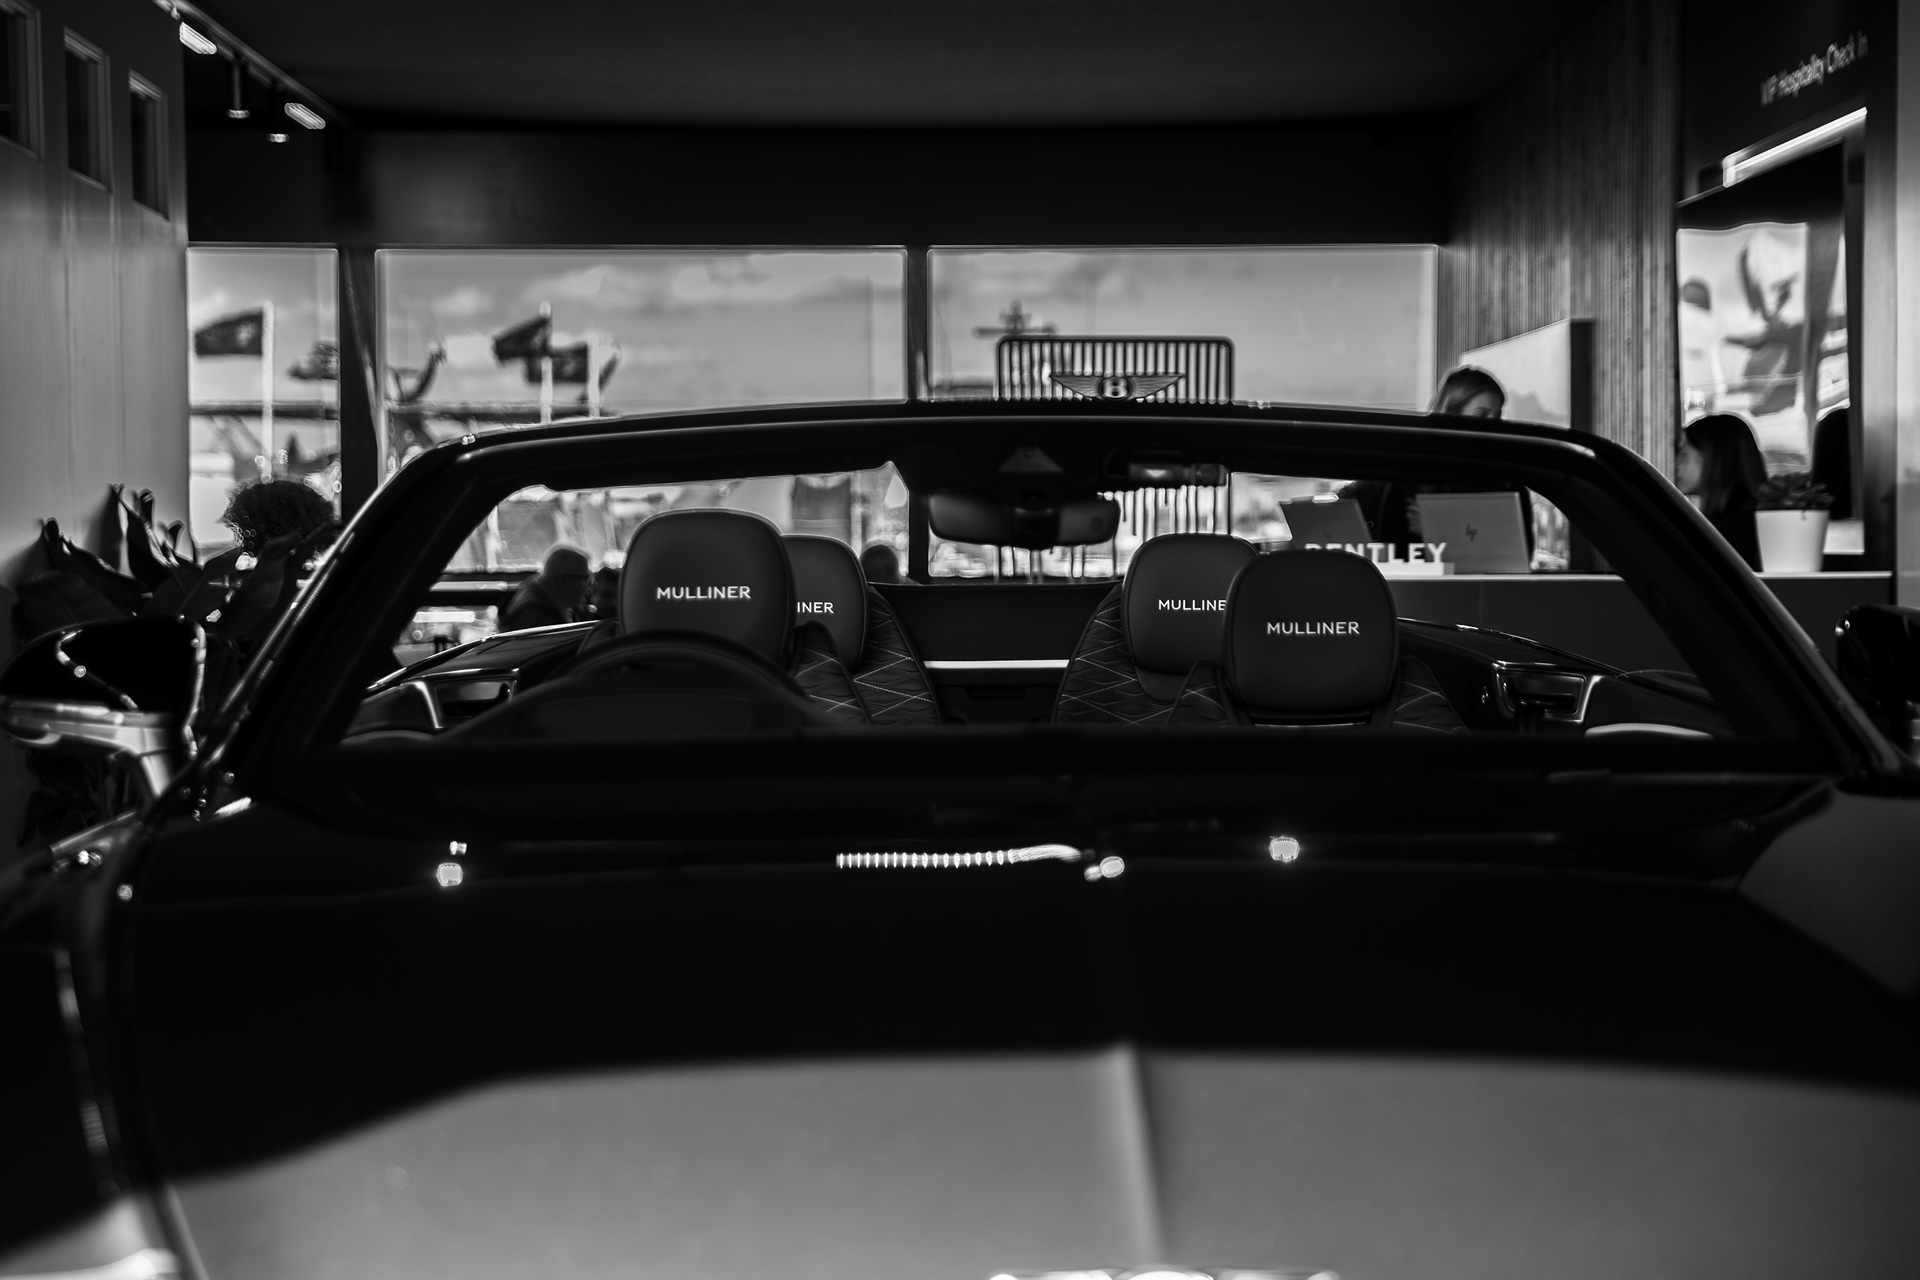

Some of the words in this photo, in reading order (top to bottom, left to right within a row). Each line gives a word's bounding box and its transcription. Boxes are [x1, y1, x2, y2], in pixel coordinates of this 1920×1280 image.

[1776, 53, 1825, 98] Hospitality
[1826, 34, 1856, 74] Check
[656, 585, 751, 600] MULLINER
[797, 601, 834, 614] INER
[1158, 599, 1227, 611] MULLINE
[1266, 621, 1360, 636] MULLINER
